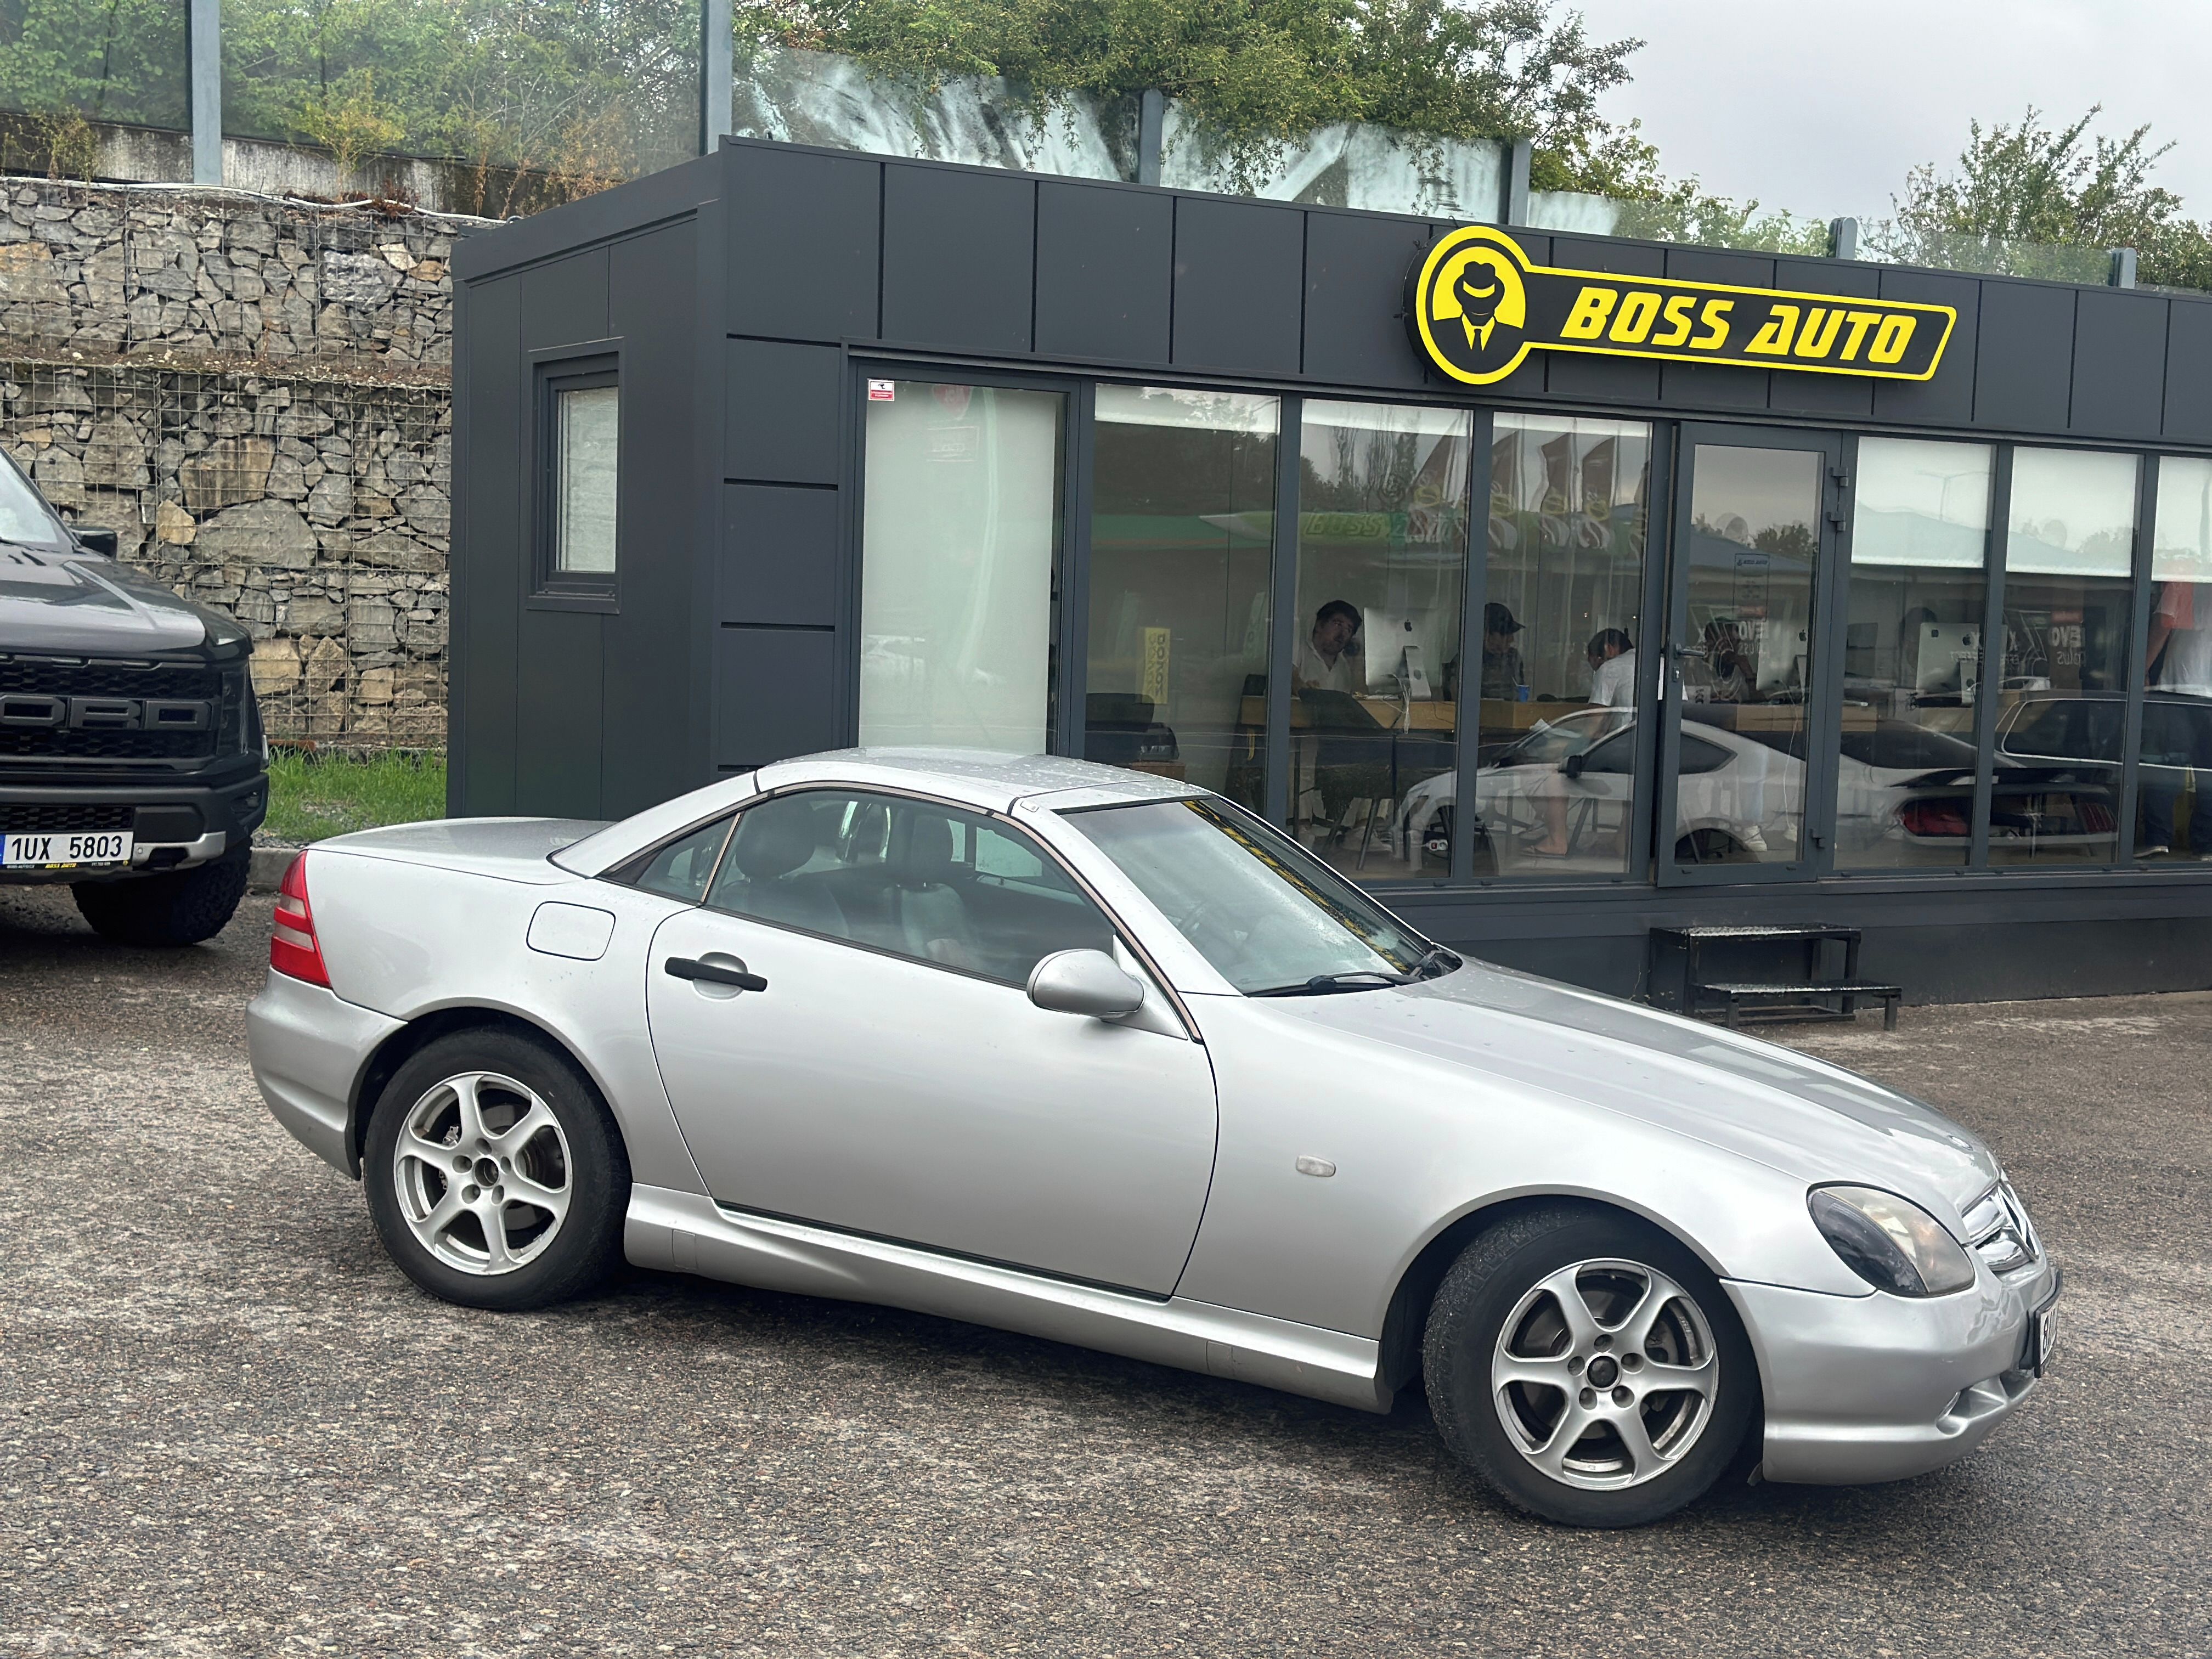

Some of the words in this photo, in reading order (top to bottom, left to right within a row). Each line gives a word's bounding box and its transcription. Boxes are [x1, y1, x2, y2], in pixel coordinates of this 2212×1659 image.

[1560, 286, 1735, 350] BOSS
[1744, 304, 1918, 364] AUTO
[12, 837, 52, 860] 1UX
[70, 836, 122, 859] 5803
